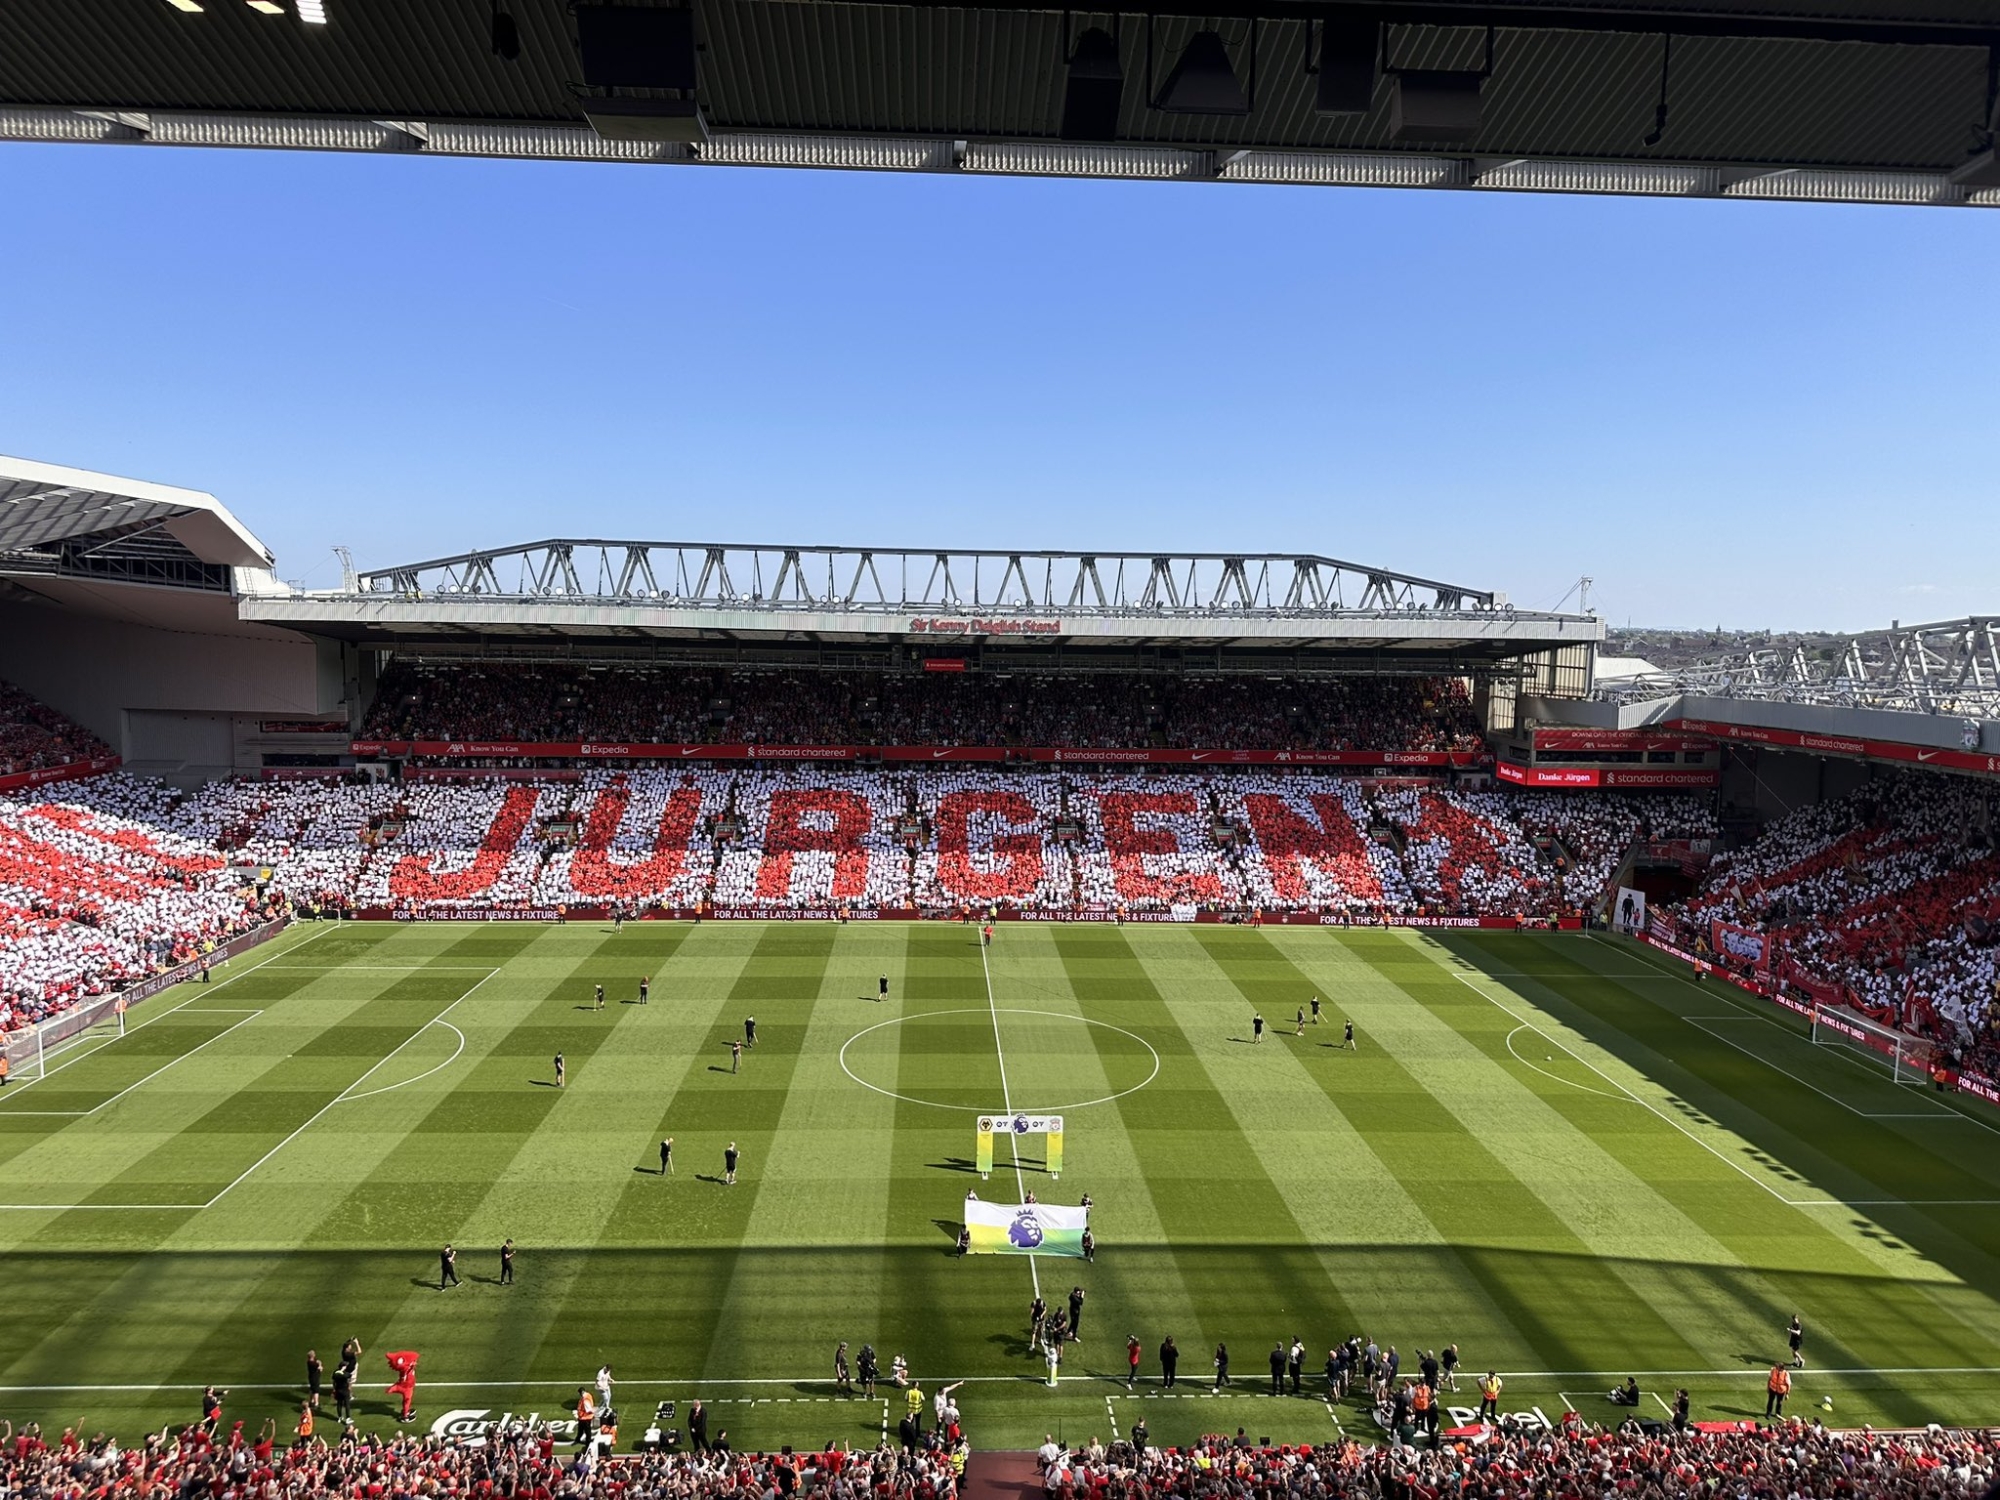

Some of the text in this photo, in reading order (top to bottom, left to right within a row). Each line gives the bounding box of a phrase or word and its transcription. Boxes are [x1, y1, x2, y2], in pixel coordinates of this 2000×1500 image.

[912, 618, 1061, 635] Sir Kenny Dalglish Stand
[447, 743, 465, 753] AXA
[592, 745, 628, 754] Expedia
[1806, 738, 1864, 752] standard chartered
[757, 747, 846, 757] standard chartered
[1064, 751, 1149, 760] standard chartered
[1274, 752, 1291, 761] AXA
[1394, 753, 1428, 763] Expedia
[1538, 772, 1590, 782] Danke Jürgen
[1617, 773, 1714, 783] standard chartered
[392, 910, 410, 919] FOR
[450, 910, 484, 920] LATEST
[485, 910, 511, 920] NEWS
[513, 910, 520, 920] &
[521, 910, 560, 920] FIXTURE
[714, 910, 731, 919] FOR
[733, 910, 749, 919] ALL
[751, 910, 768, 919] THE
[803, 910, 828, 919] NEWS
[829, 910, 836, 919] &
[1021, 912, 1037, 920] FOR
[1038, 912, 1054, 920] ALL
[1074, 912, 1105, 921] LATEST
[1106, 912, 1131, 921] NES
[1132, 912, 1138, 921] &
[1140, 912, 1174, 922] FIXTURE
[1320, 915, 1336, 924] FOR
[1338, 916, 1354, 925] AL
[1406, 917, 1431, 926] NEWS
[1432, 917, 1438, 926] &
[1440, 917, 1480, 927] FIXTURES
[131, 989, 144, 1002] ALL
[144, 980, 158, 995] THE
[157, 971, 179, 989] LATES
[1776, 993, 1786, 1005] FOR
[1785, 997, 1794, 1009] ALL
[1794, 1002, 1804, 1013] THE
[1820, 1014, 1836, 1027] NEWS
[1835, 1021, 1840, 1029] &
[1958, 1076, 1999, 1102] FOR ALL THE
